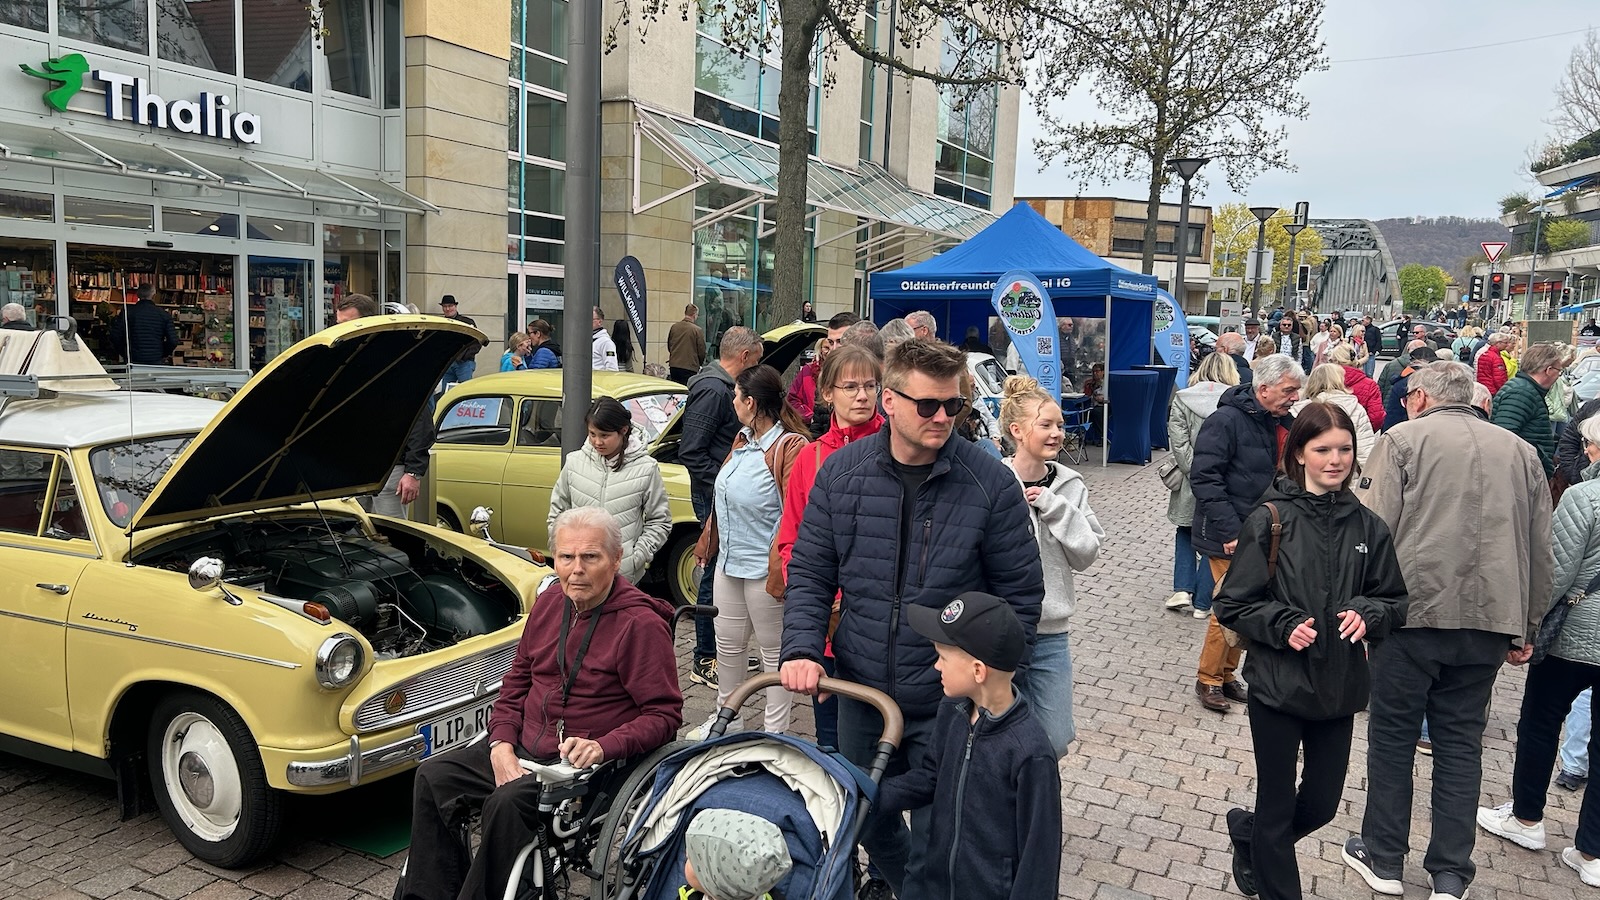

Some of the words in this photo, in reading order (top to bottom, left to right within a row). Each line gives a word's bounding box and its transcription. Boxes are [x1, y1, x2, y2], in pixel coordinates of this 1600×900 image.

[93, 70, 262, 144] Thalia
[901, 280, 999, 291] Oldtimerfreunde
[1056, 277, 1071, 288] IG
[617, 276, 643, 333] WILLKOMMEN
[457, 407, 486, 418] SALE
[434, 716, 464, 750] LIP
